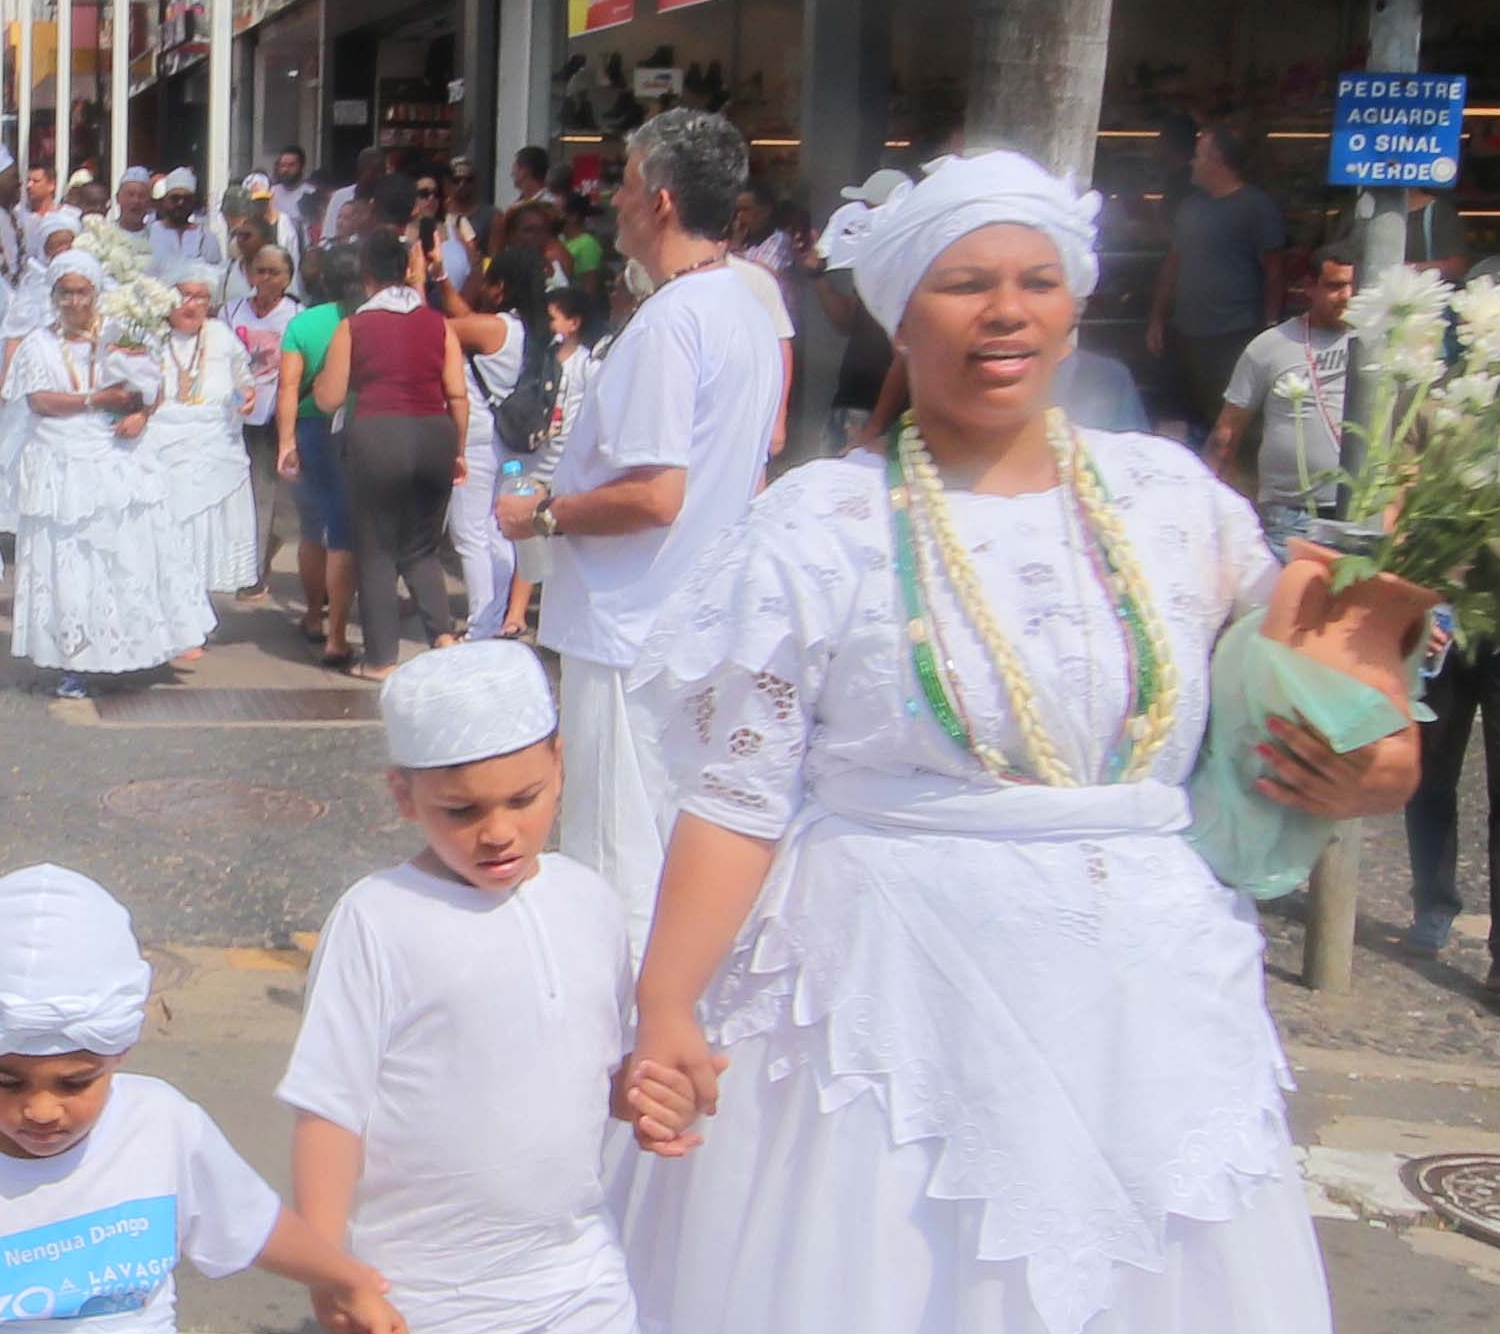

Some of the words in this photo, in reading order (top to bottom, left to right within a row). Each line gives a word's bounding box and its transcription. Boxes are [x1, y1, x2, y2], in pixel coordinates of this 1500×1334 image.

[1338, 80, 1462, 100] PEDESTRE
[1346, 107, 1450, 127] AGUARDE
[1349, 133, 1367, 152] O
[1375, 134, 1442, 154] SINAL
[1356, 162, 1432, 181] VERDE
[4, 1234, 86, 1269] Nengua
[90, 1216, 150, 1245] Dango
